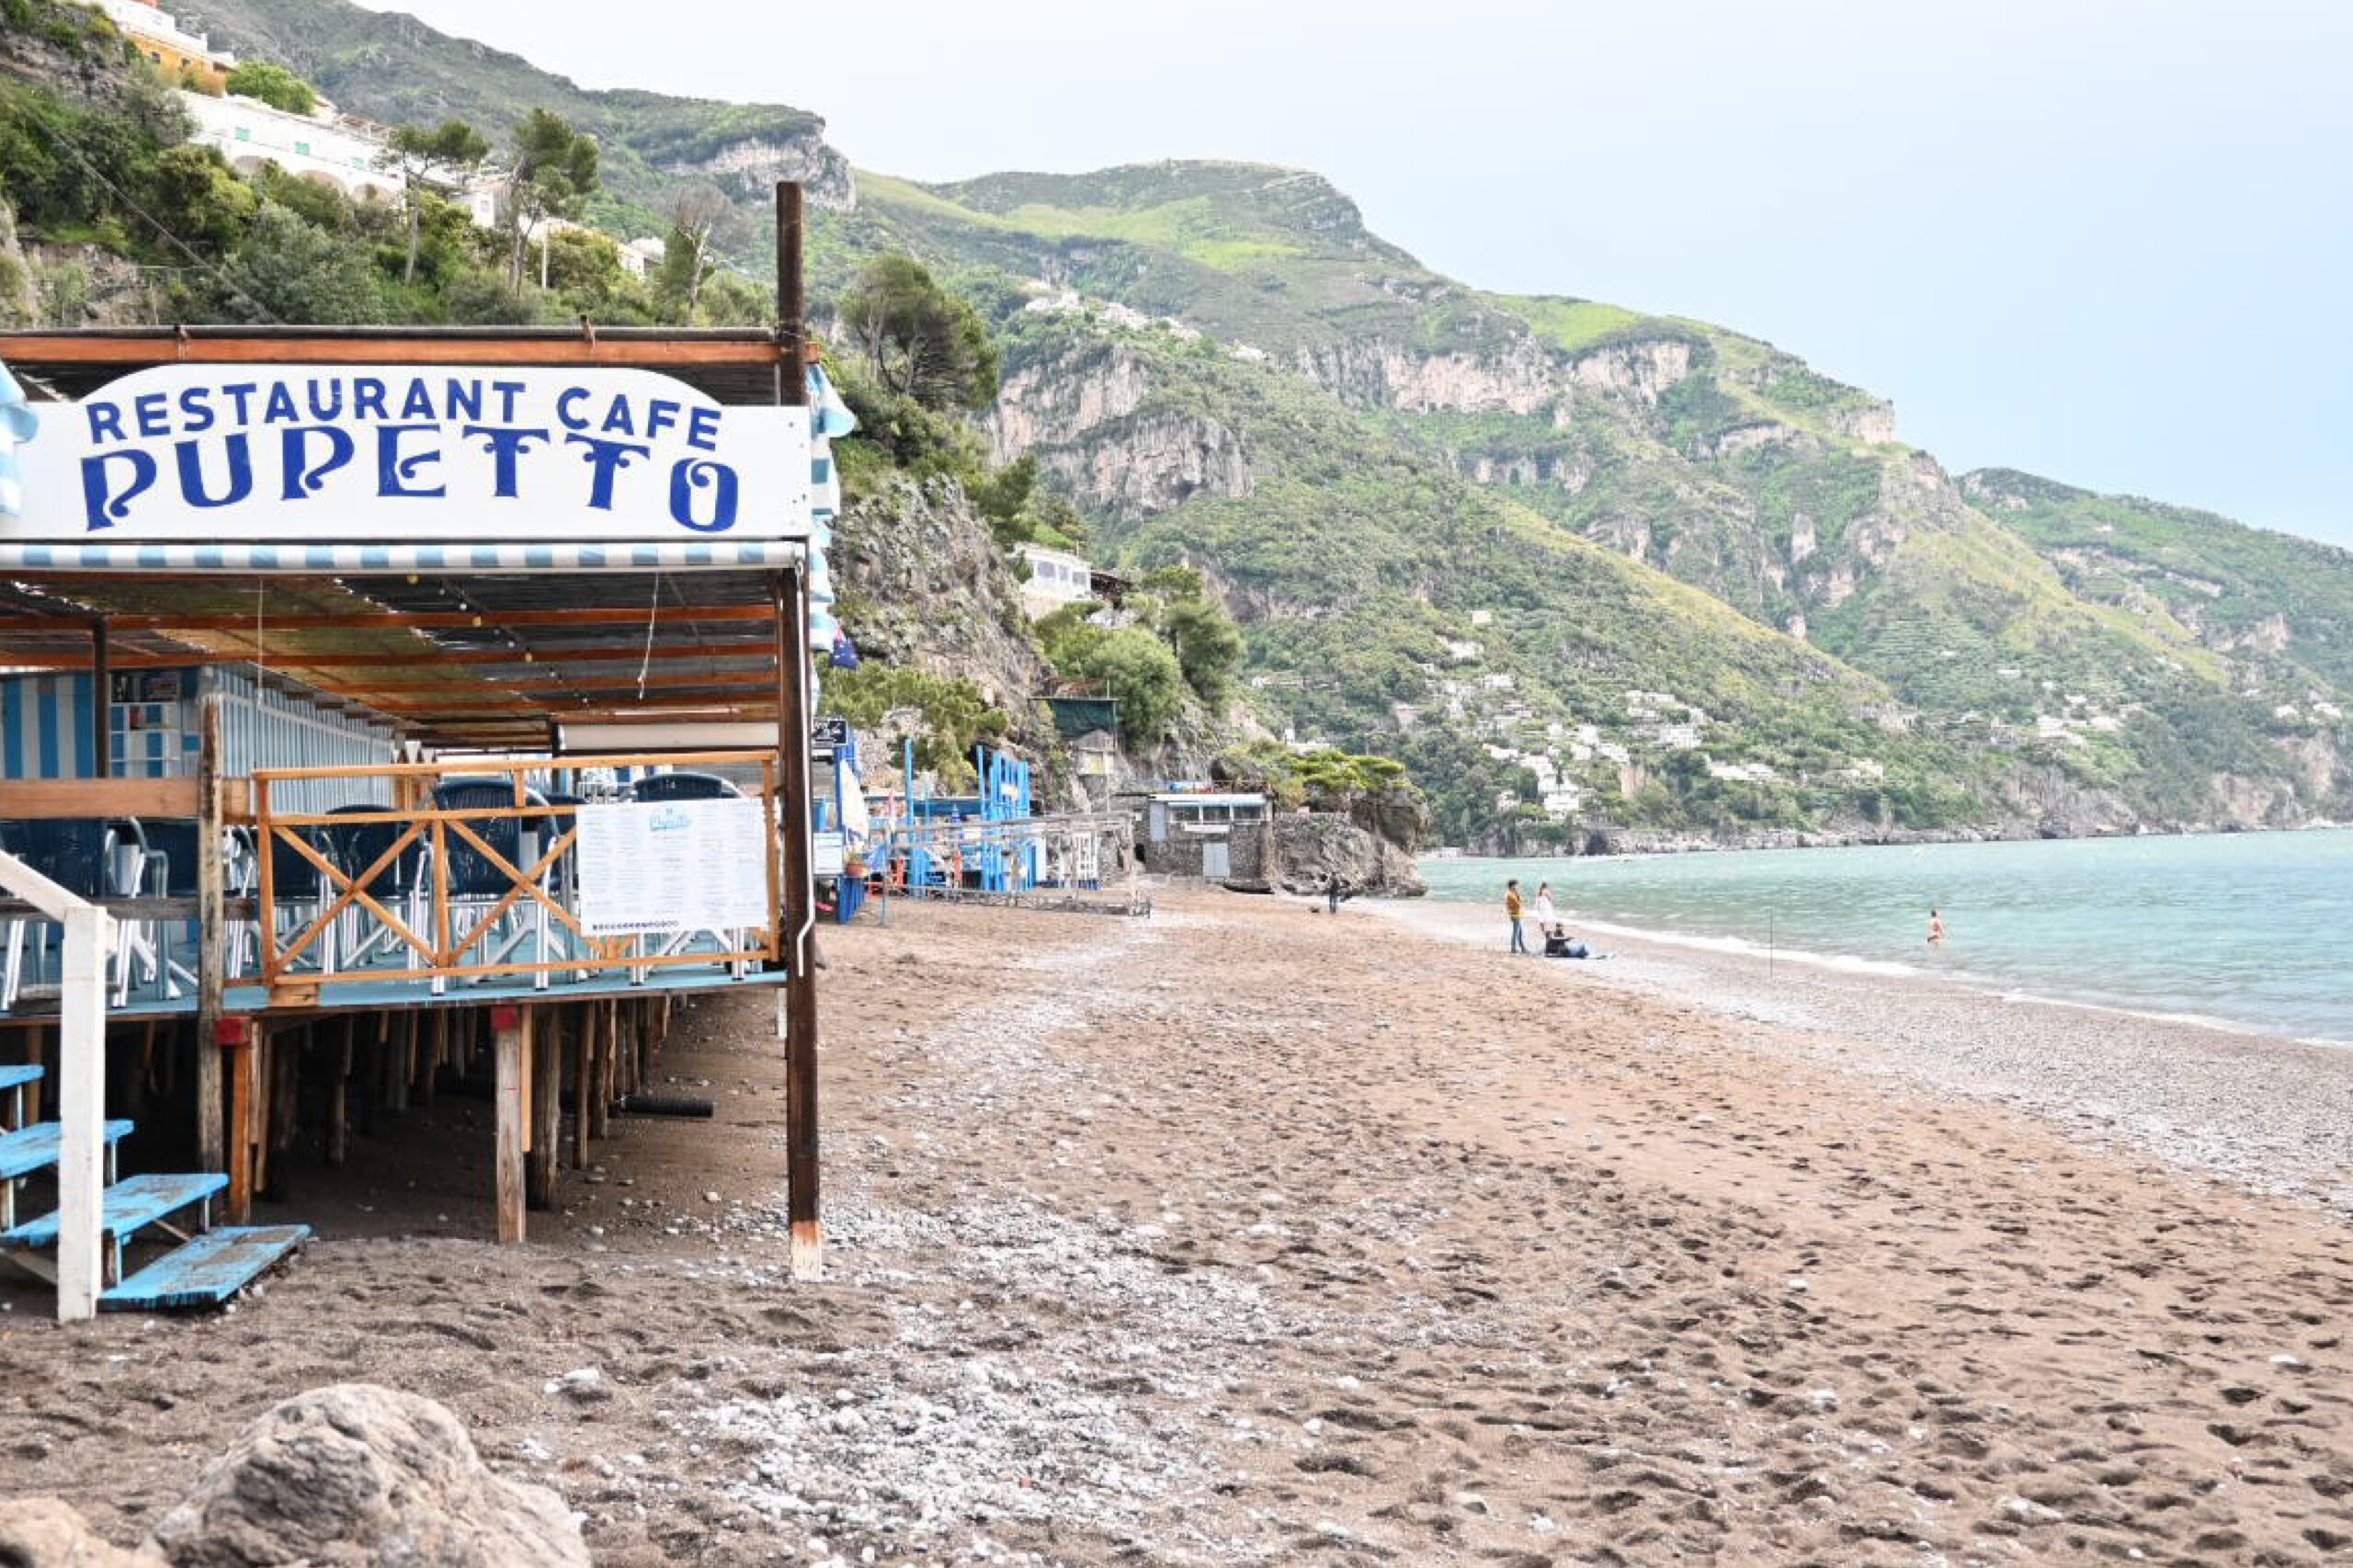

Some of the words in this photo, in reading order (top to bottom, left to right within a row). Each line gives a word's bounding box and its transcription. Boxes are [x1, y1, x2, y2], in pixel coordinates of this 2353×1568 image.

[86, 378, 527, 444] RESTAURANT
[557, 387, 722, 451] CAFE
[81, 426, 739, 532] PUPETTO
